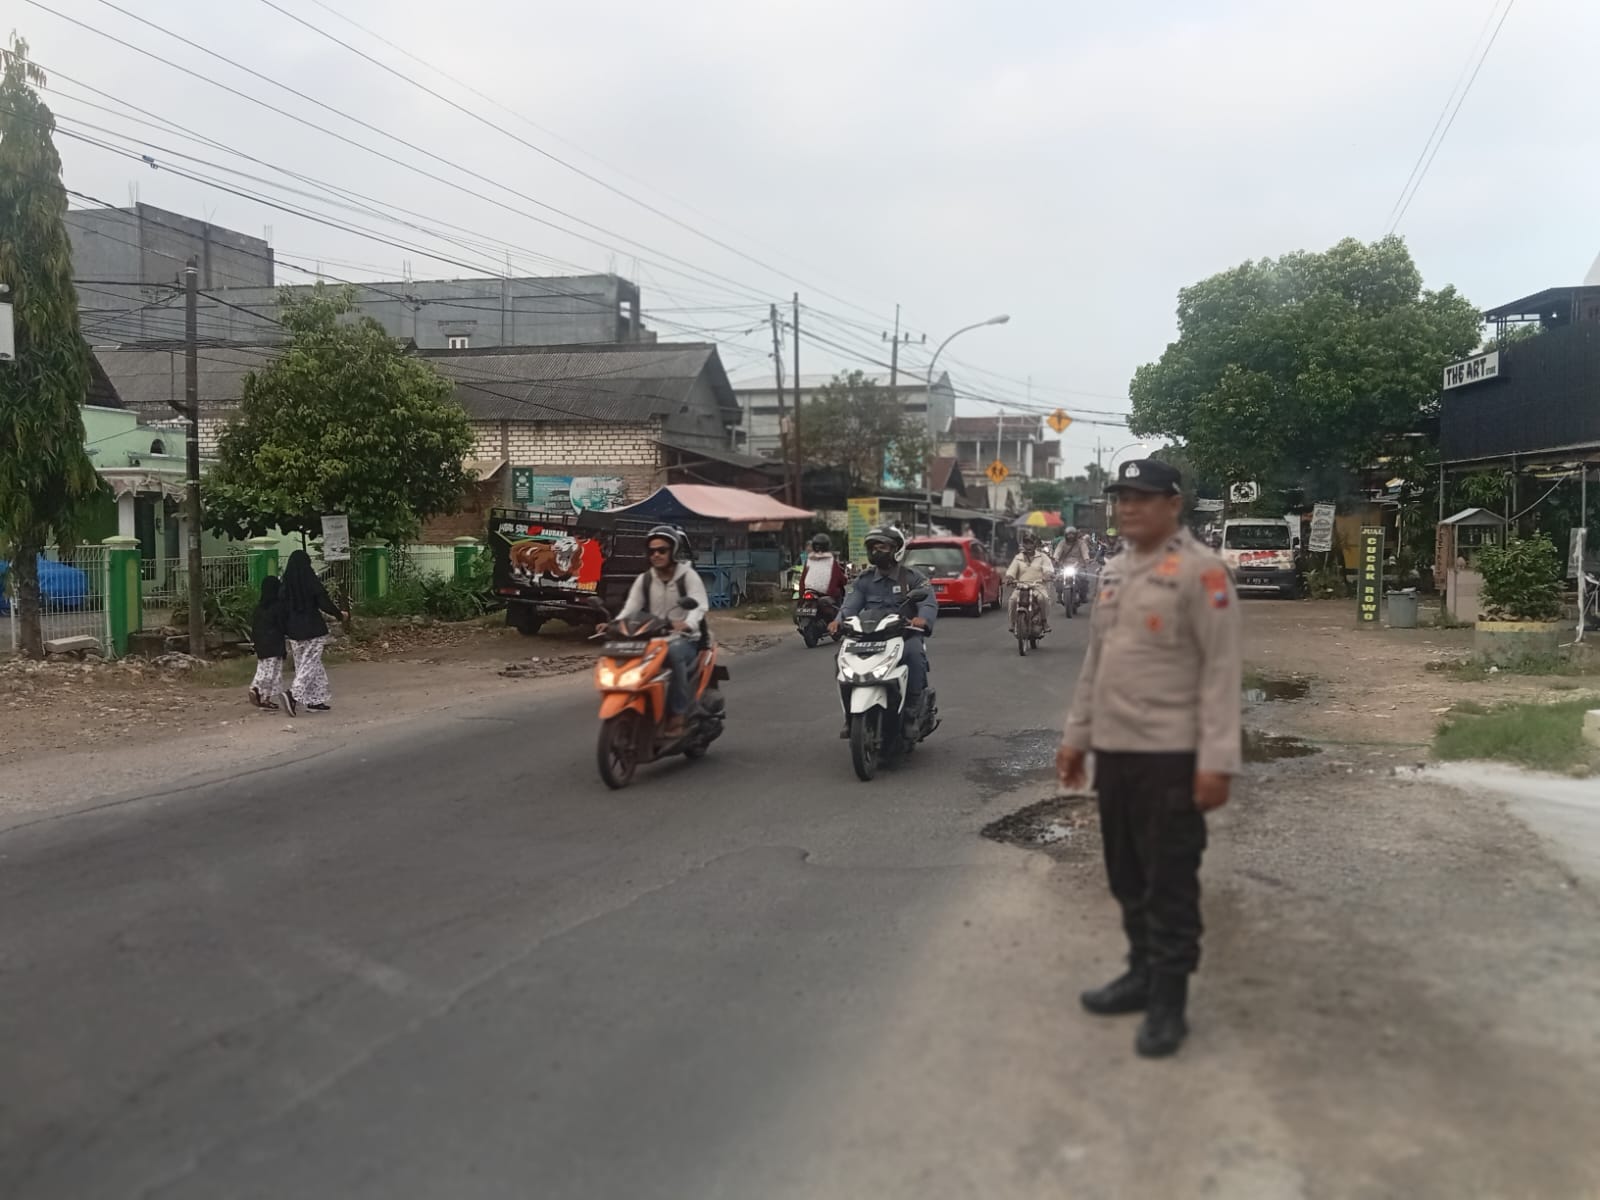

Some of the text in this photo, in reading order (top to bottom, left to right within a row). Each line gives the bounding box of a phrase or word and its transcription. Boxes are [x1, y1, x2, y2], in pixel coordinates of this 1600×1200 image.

[1446, 364, 1465, 387] THE
[1466, 357, 1487, 380] ART
[1365, 537, 1377, 581] CUCAK
